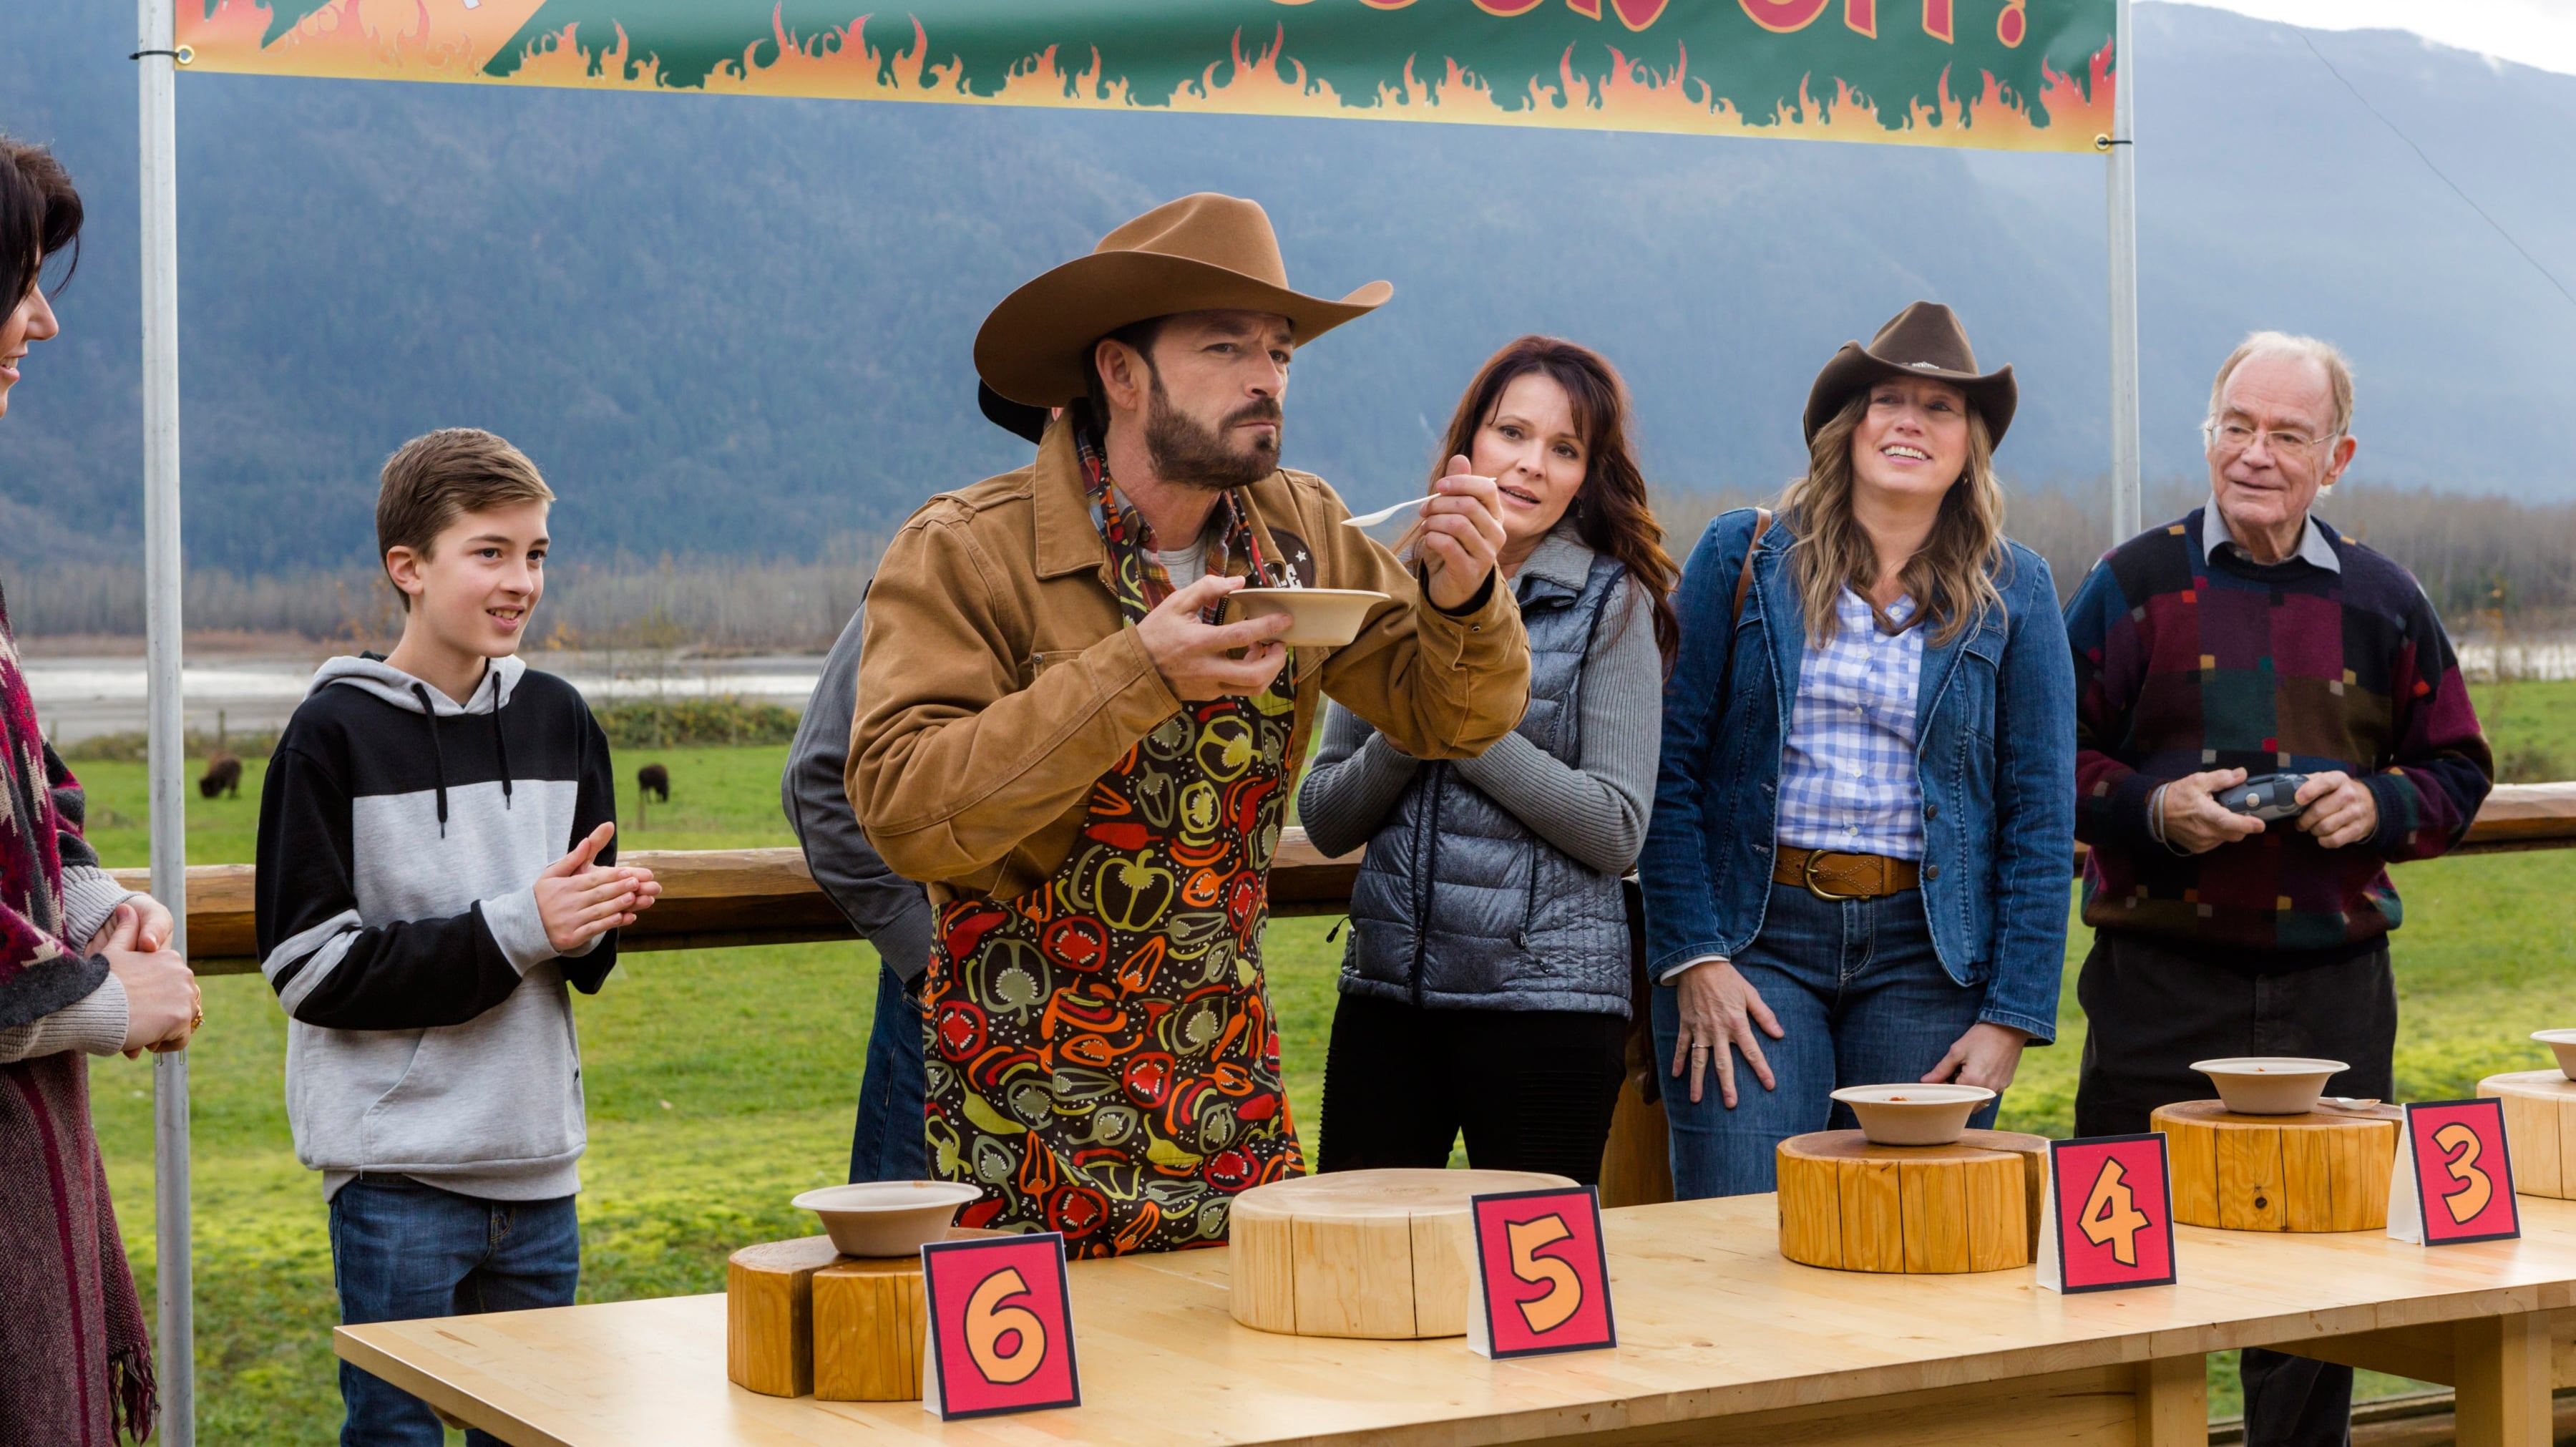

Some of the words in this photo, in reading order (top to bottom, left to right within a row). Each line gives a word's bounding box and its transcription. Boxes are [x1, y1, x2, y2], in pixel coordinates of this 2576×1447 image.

[2077, 1155, 2152, 1269] 4
[2431, 1121, 2493, 1226] 3
[963, 1265, 1048, 1386] 6
[1503, 1212, 1584, 1335] 5
